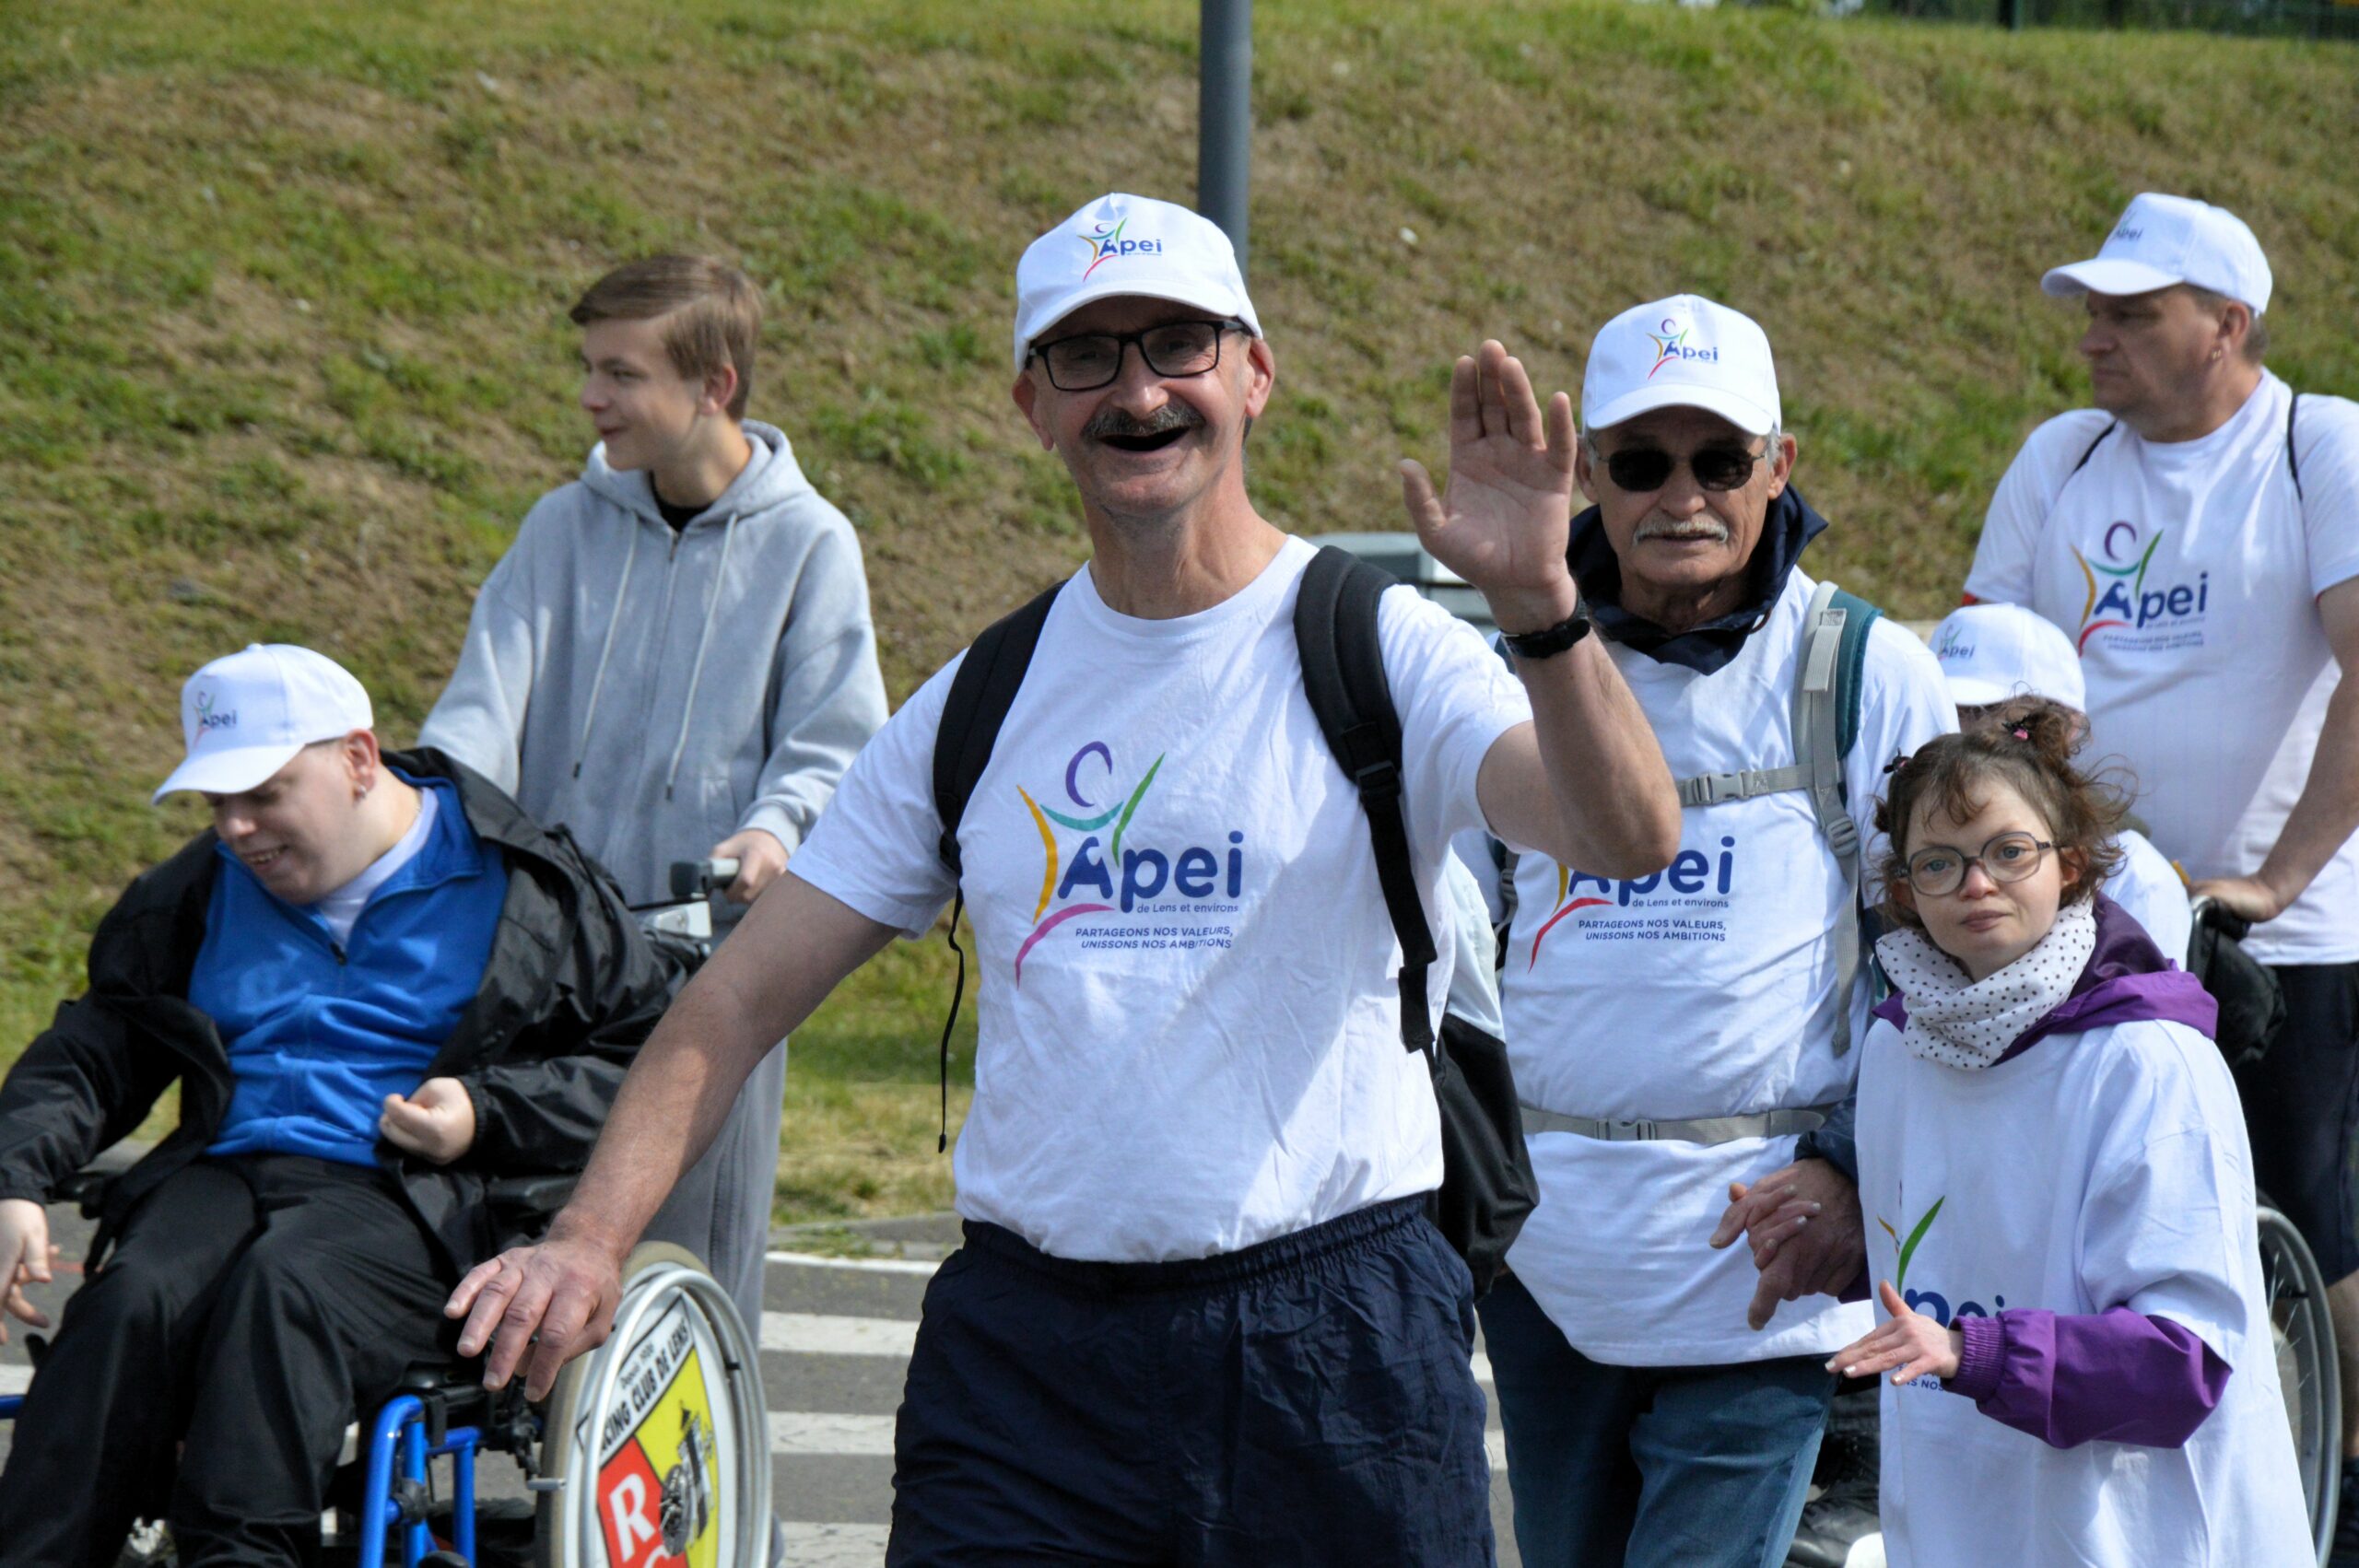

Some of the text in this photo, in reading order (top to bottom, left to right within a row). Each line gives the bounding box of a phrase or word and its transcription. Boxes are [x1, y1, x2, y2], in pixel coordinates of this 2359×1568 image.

[1098, 239, 1162, 256] Apei
[1663, 341, 1718, 361] Apei
[2094, 570, 2208, 629] Apei
[1058, 830, 1244, 913] Apei
[1136, 903, 1238, 913] de Lens et environs
[1632, 898, 1729, 908] de Lens et environs
[1075, 926, 1233, 938] PARTAGEONS NOS VALEURS,
[1579, 919, 1727, 931] PARTAGEONS NOS VALEURS,
[1586, 930, 1726, 942] UNISSONS NOS AMBITIONS
[1081, 938, 1232, 949] UNISSONS NOS AMBITIONS
[602, 1317, 688, 1450] CING CLUB DE LENS
[609, 1473, 672, 1568] R
